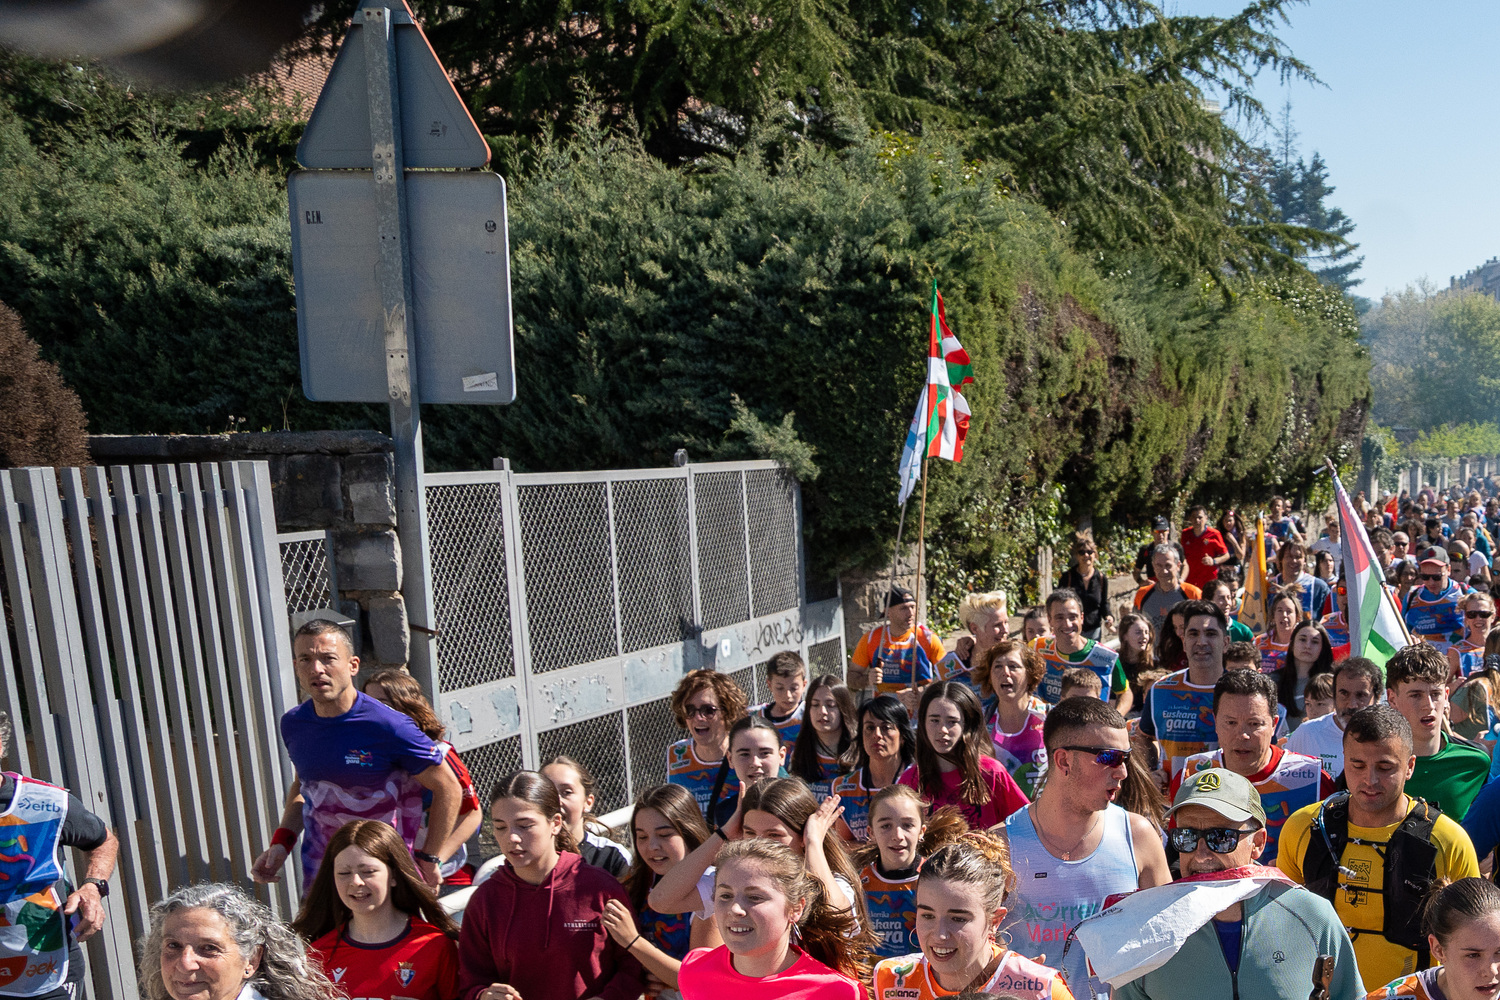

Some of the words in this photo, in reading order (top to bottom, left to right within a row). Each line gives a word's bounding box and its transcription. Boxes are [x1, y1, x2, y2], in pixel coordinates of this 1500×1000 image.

[1163, 711, 1197, 720] Euskara
[1166, 718, 1196, 731] gara
[1290, 768, 1315, 780] eitb
[32, 801, 61, 813] eitb
[25, 960, 57, 976] aek
[1013, 975, 1044, 991] eitb
[884, 988, 919, 999] goiener
